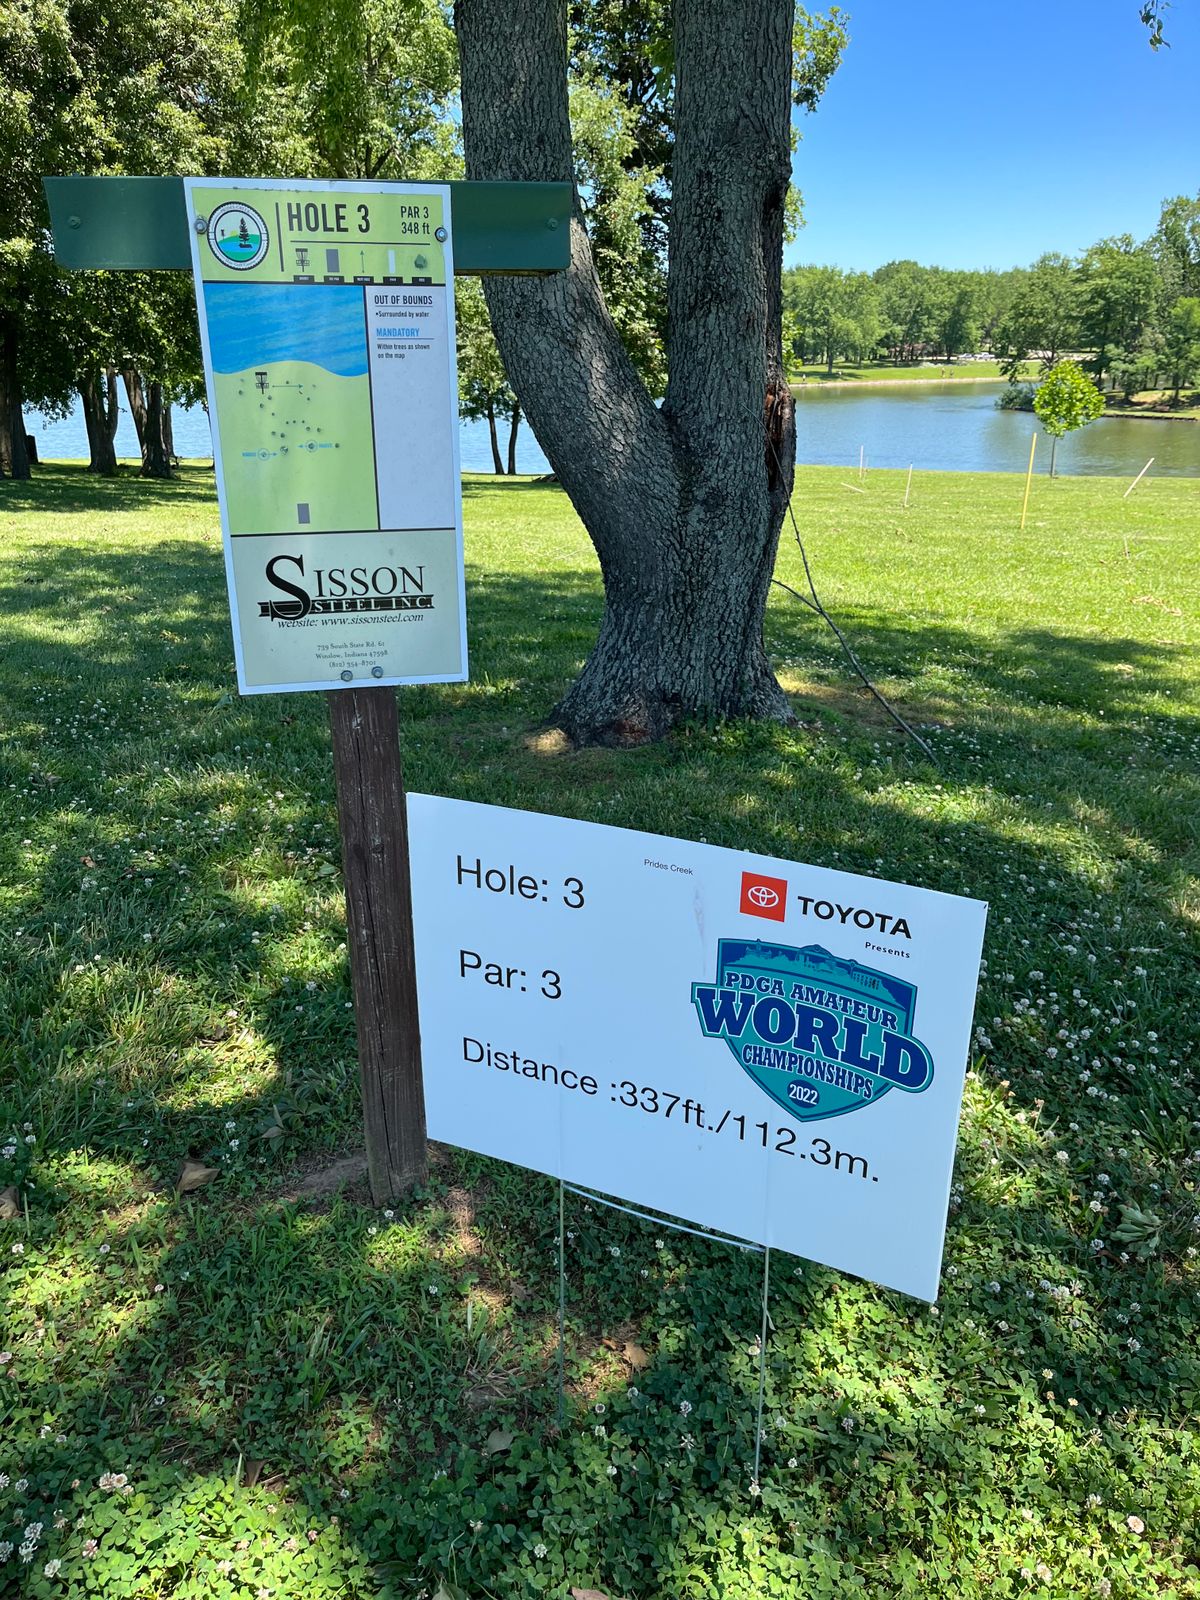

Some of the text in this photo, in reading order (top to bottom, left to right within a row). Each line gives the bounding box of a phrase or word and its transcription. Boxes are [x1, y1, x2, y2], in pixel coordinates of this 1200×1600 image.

[287, 202, 370, 233] HOLE 3
[400, 205, 429, 219] PAR 3
[401, 222, 430, 234] 348 ft
[374, 294, 433, 305] OUT OF BOUNDS
[408, 310, 415, 319] by
[376, 327, 420, 337] MANDATORY
[265, 554, 426, 622] SISSON
[314, 596, 431, 613] STEEL INC.
[277, 613, 424, 629] website: www.sissonsteel.com
[644, 858, 694, 876] Prides Creek
[456, 854, 585, 909] Hole: 3
[797, 895, 912, 939] TOYOTA
[864, 941, 911, 959] Presents
[460, 949, 562, 1000] Par: 3
[725, 971, 898, 1030] PDGA AMATEUR
[696, 987, 930, 1089] WORLD
[462, 1036, 598, 1095] Distance
[742, 1044, 873, 1099] CHAMPIONSHIPS
[788, 1083, 818, 1105] 2022
